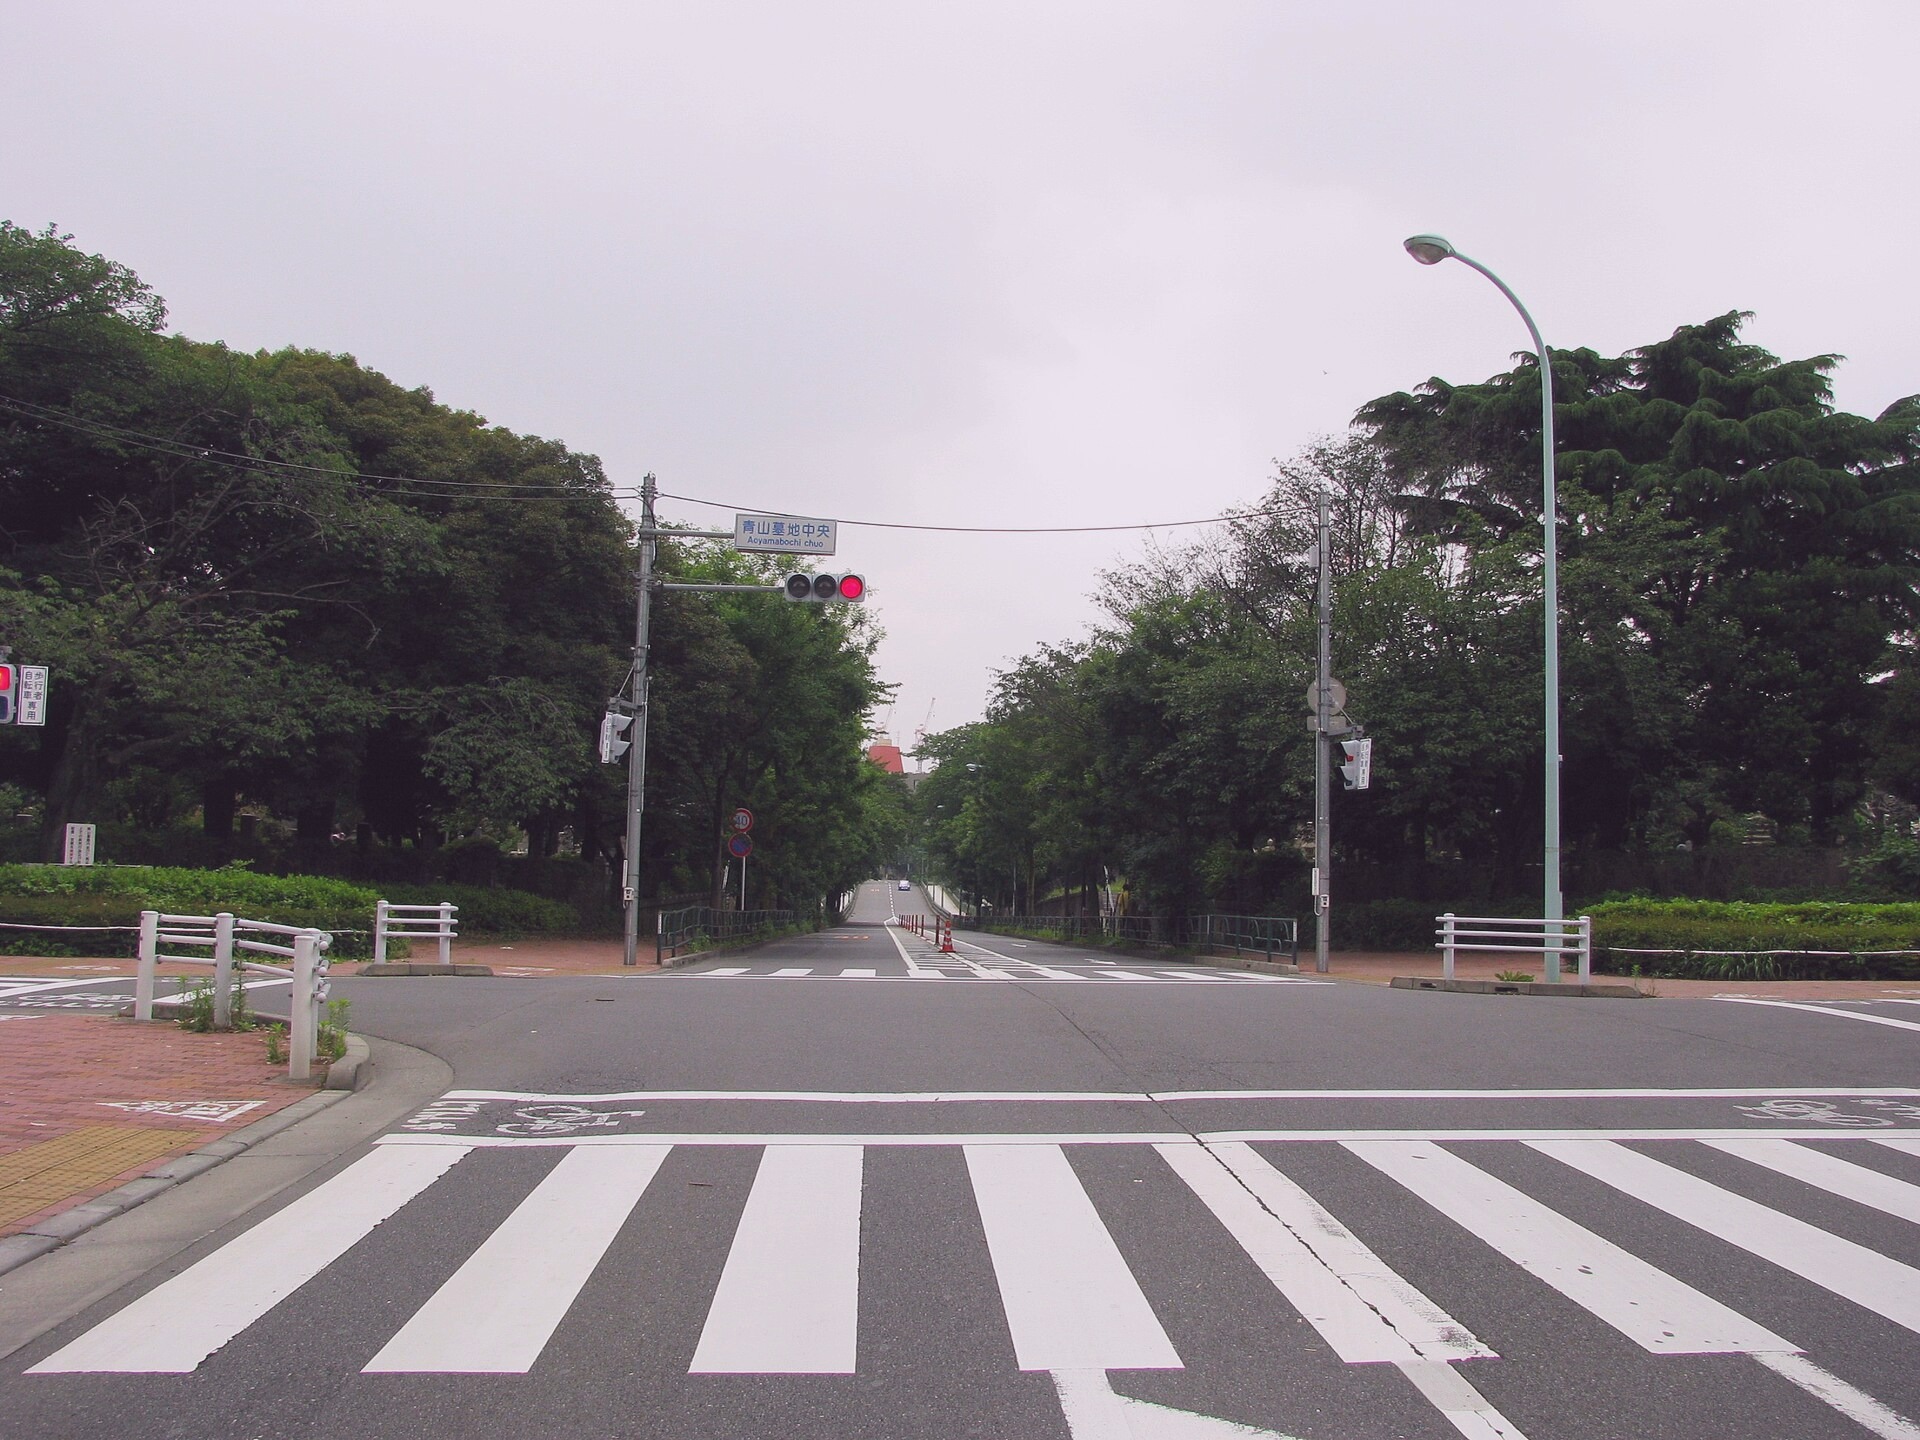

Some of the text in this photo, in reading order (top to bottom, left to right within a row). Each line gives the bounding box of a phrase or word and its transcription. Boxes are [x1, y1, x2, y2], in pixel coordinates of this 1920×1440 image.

[742, 520, 830, 538] 青山墓地中央
[747, 536, 823, 548] Aoyamabochi chuo
